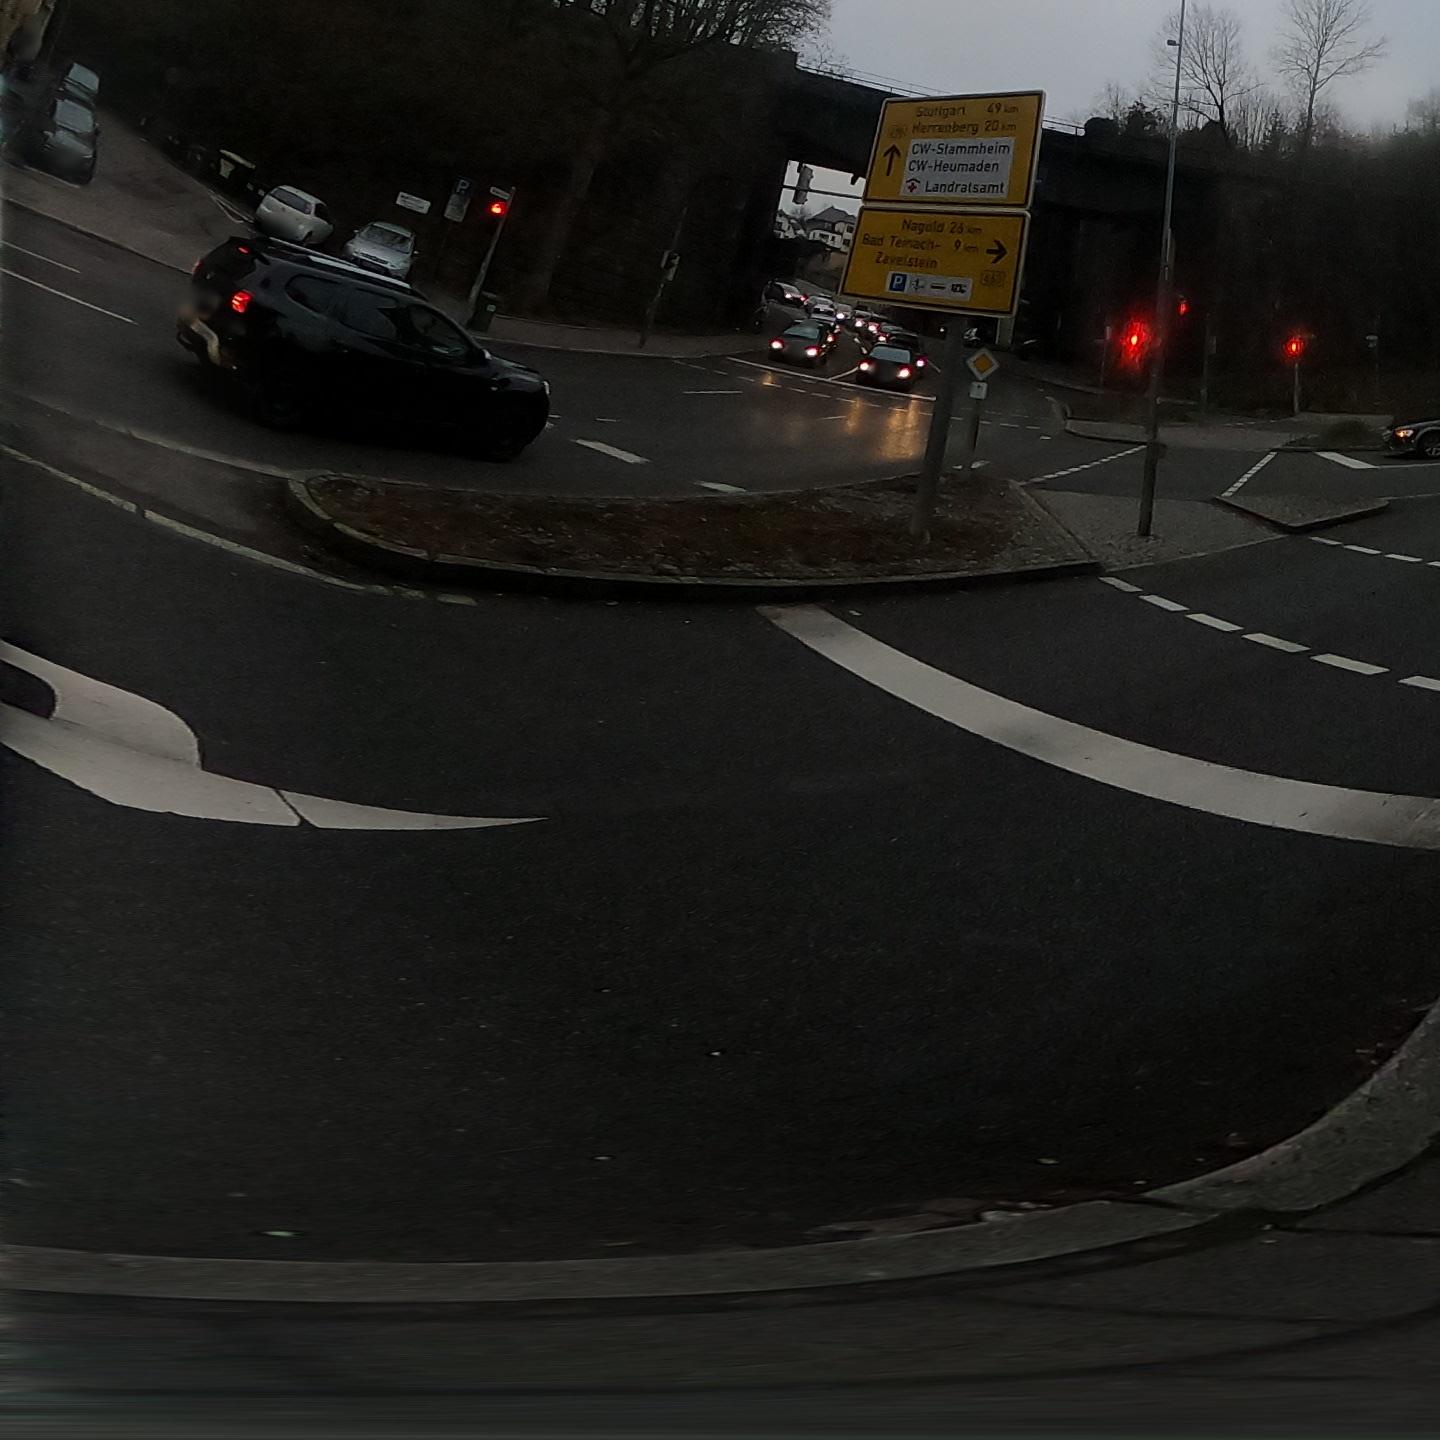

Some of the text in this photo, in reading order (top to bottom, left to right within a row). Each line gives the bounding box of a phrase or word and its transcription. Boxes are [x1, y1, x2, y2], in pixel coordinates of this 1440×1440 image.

[915, 102, 1019, 118] Stuttgart 49 km
[912, 121, 979, 135] Herrenberg
[984, 120, 999, 132] 20
[1001, 122, 1017, 132] km
[911, 142, 1010, 155] CW-Stammheim
[908, 159, 999, 173] CW-Heumaden
[924, 180, 1005, 194] Landratsamt
[901, 218, 945, 235] Nagold
[949, 221, 964, 234] 26
[863, 234, 884, 246] Bad
[953, 239, 962, 253] 9
[875, 251, 938, 269] Zavelstein
